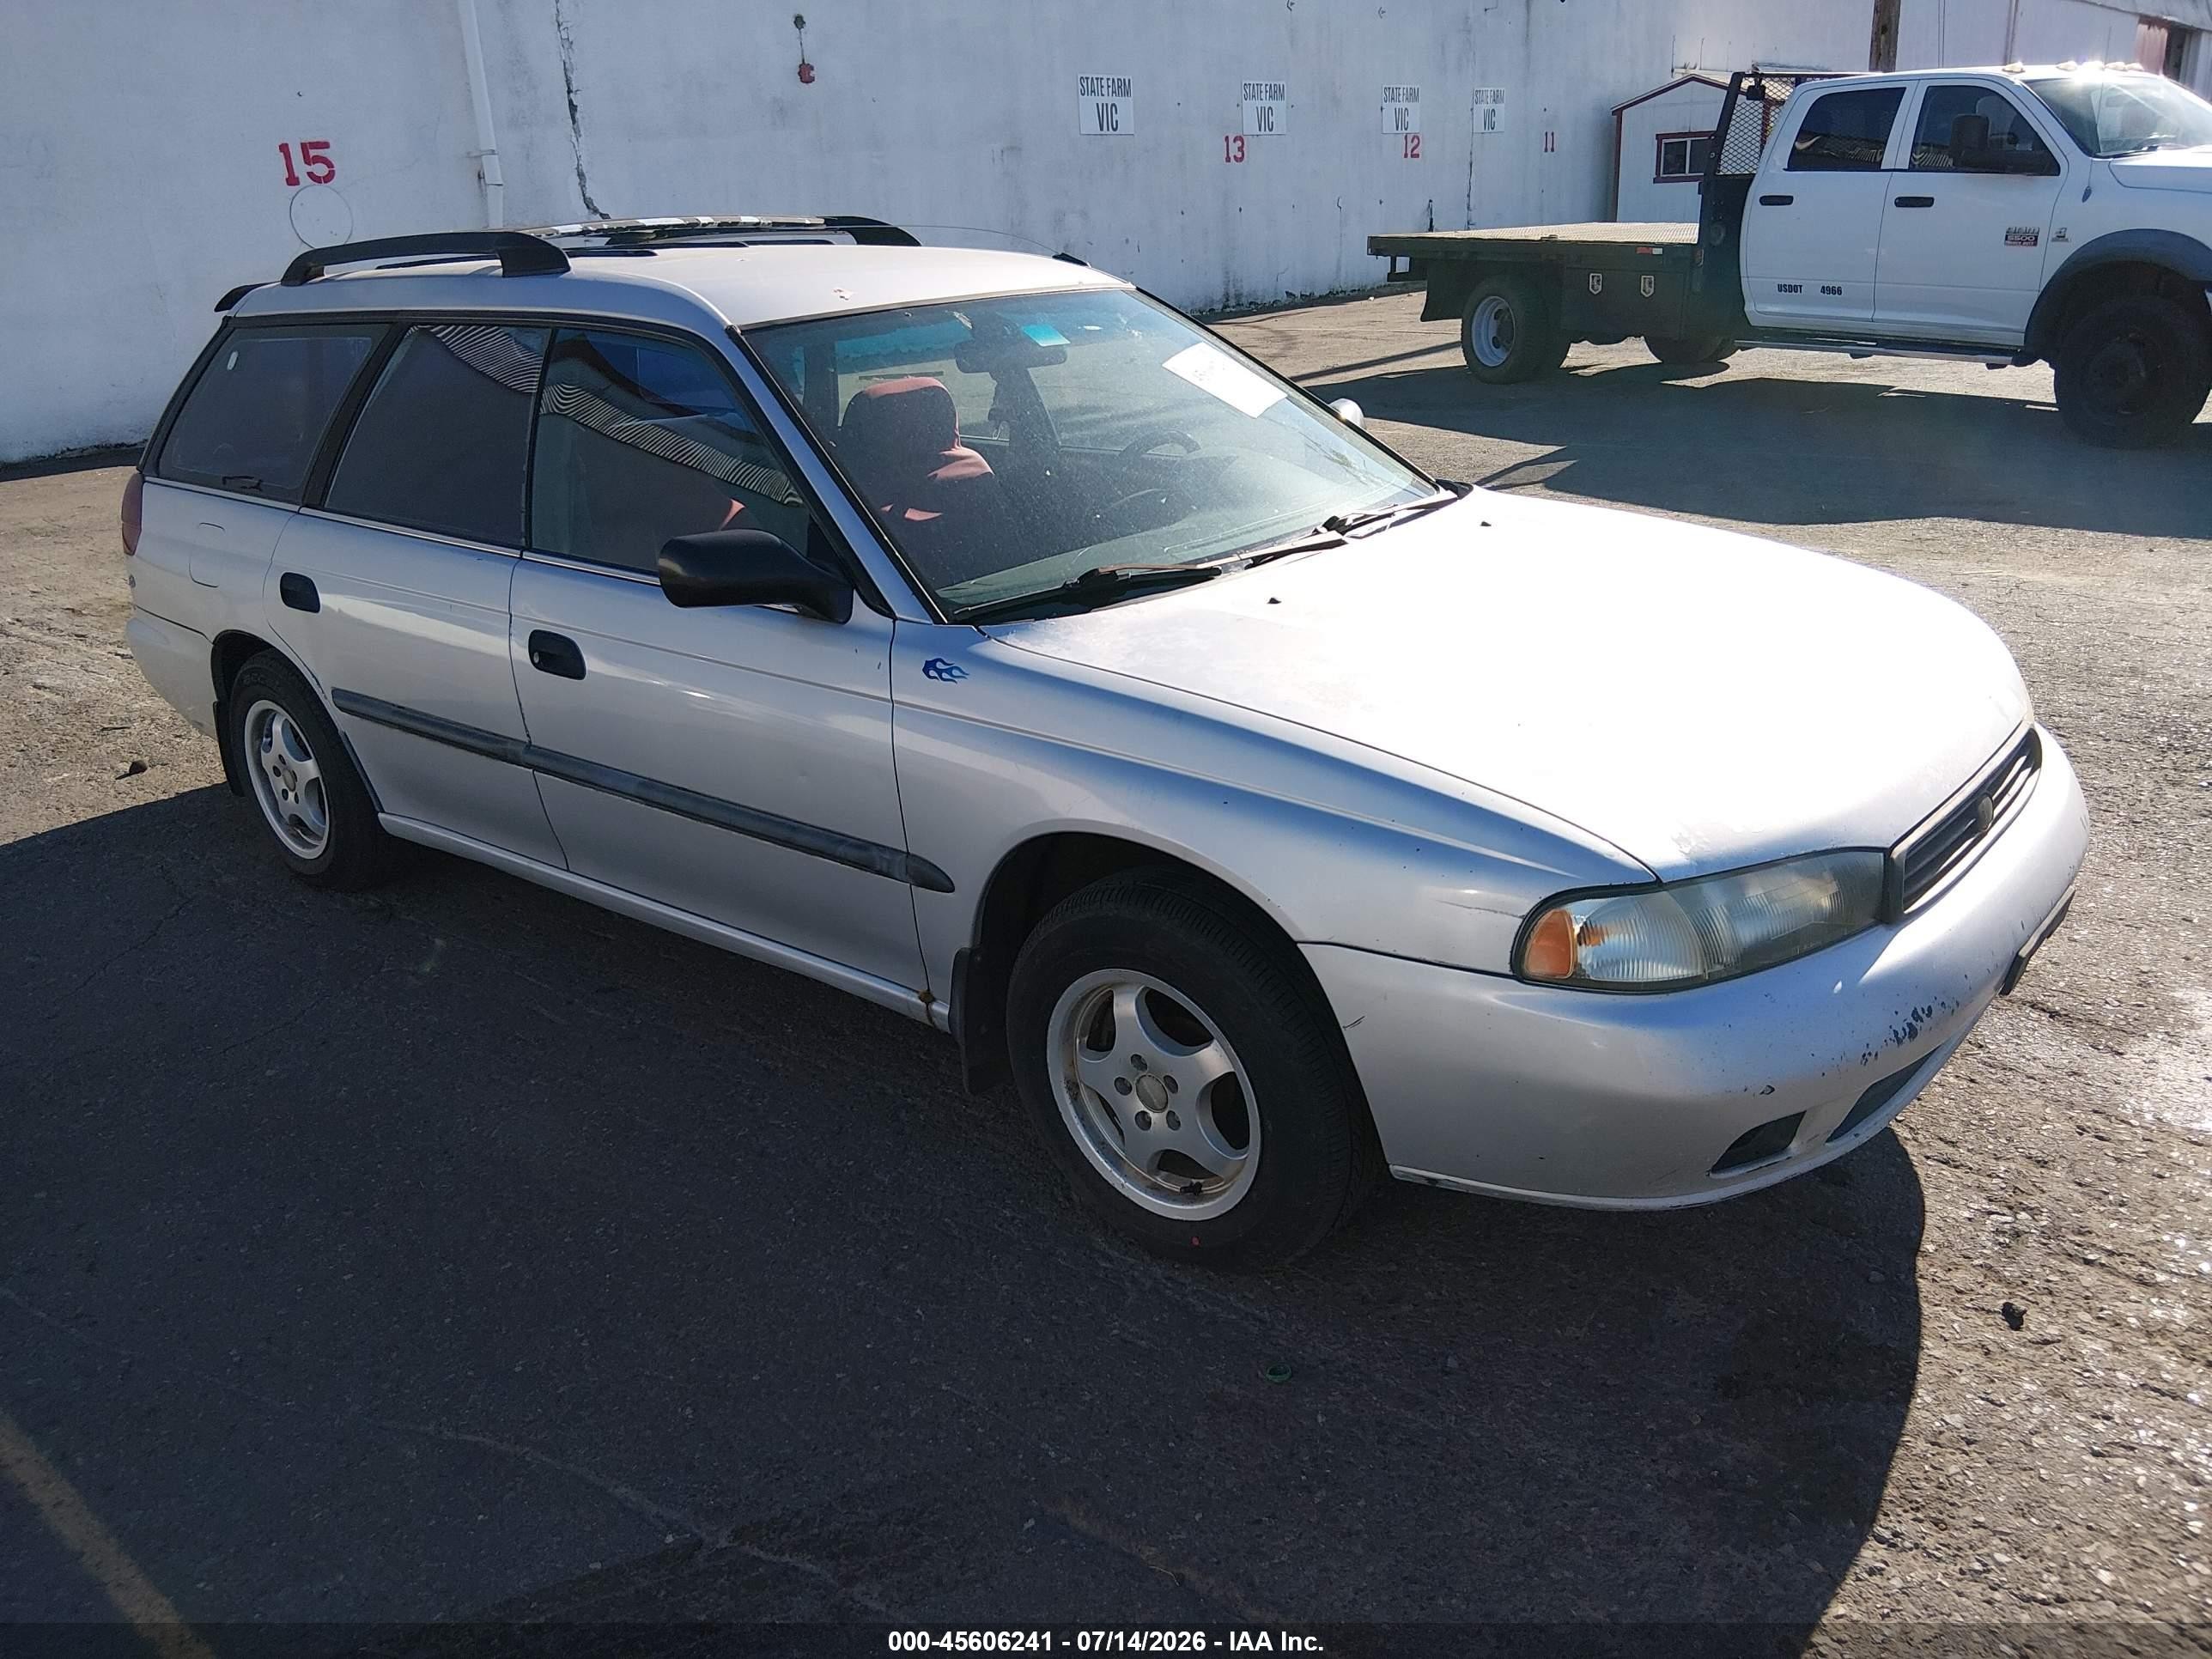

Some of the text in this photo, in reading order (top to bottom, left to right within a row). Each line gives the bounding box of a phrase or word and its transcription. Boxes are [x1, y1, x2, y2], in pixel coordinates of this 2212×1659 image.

[1079, 76, 1132, 98] STATE FARM
[1243, 83, 1285, 101] STATE FARM
[1383, 87, 1419, 104] STATE FARM
[1474, 89, 1504, 105] STATE FARM
[1096, 102, 1119, 132] VIC
[1256, 106, 1274, 132] VIC
[1394, 107, 1409, 131] VIC
[1483, 108, 1496, 131] VIC
[1224, 135, 1245, 163] 13
[1403, 134, 1420, 159] 12
[1544, 131, 1555, 153] 11
[278, 141, 336, 186] 15
[1777, 283, 1843, 295] USDOT 4966
